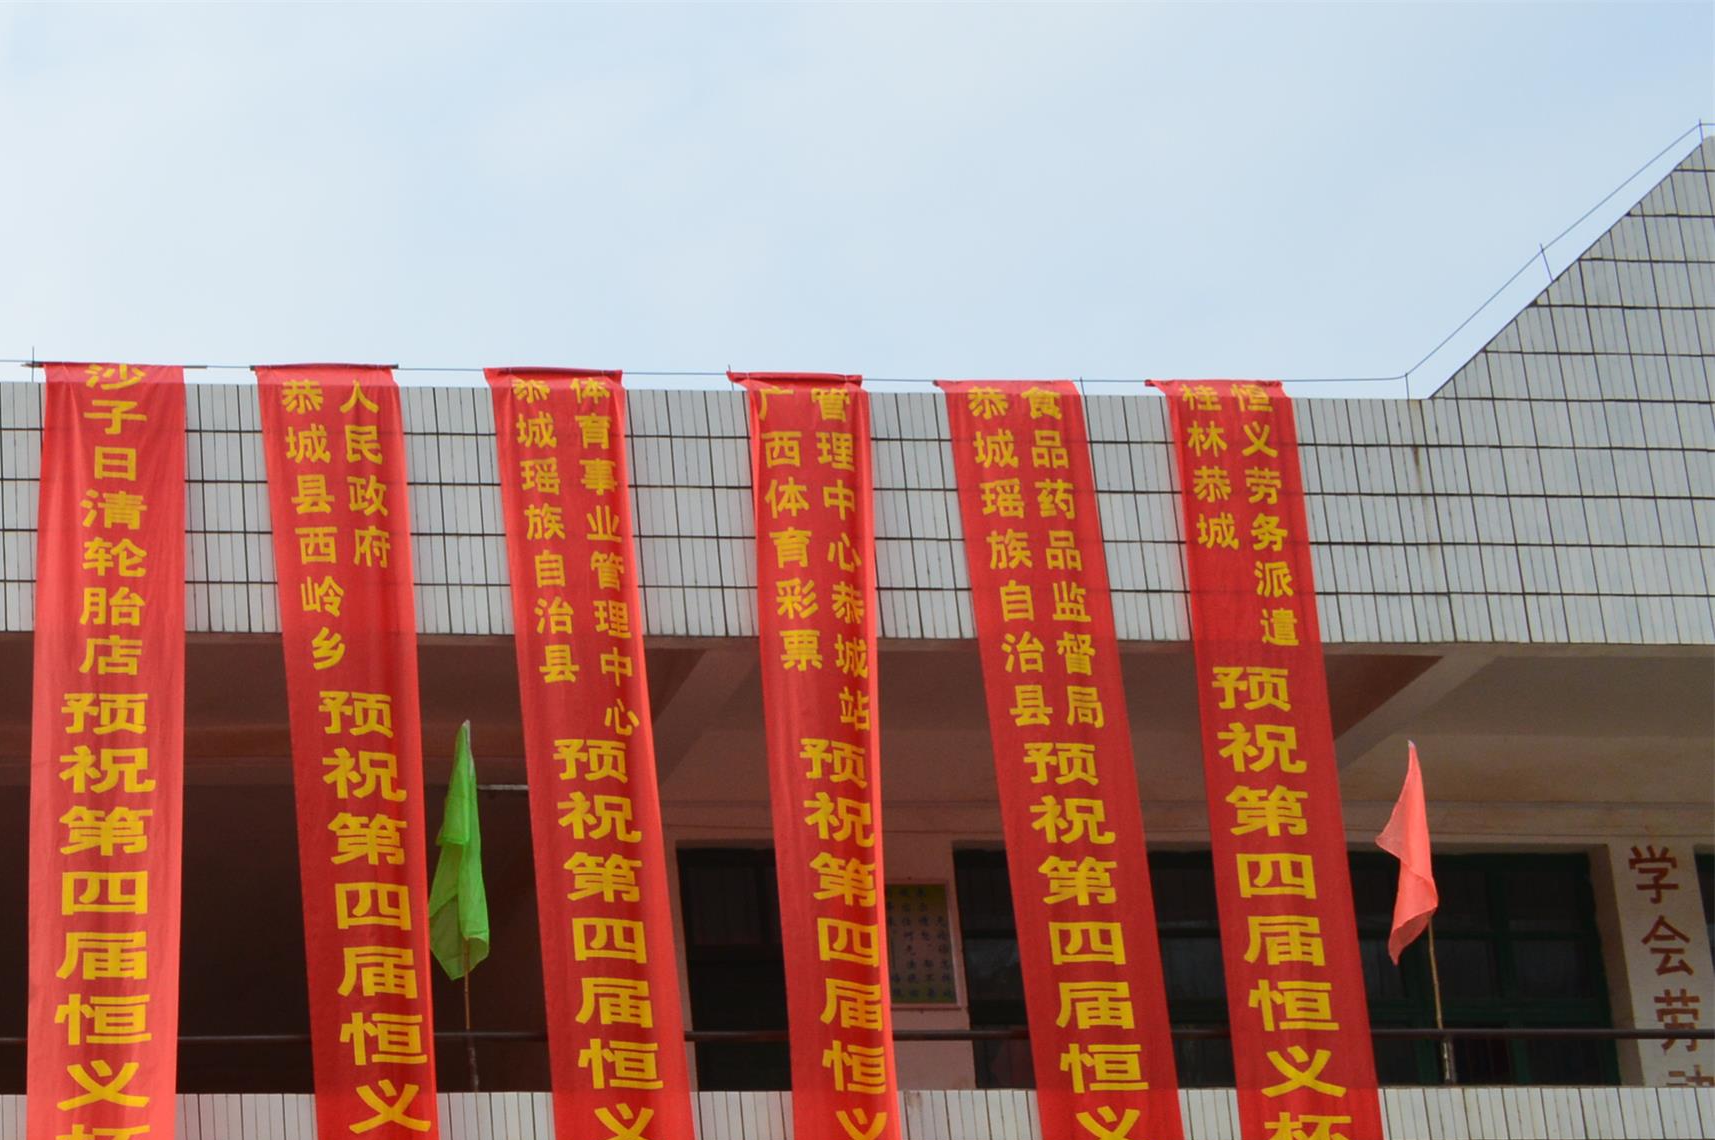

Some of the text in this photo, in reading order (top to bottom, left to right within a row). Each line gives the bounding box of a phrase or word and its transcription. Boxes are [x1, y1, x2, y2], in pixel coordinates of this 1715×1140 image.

[282, 380, 345, 670] 恭城县西岭乡
[340, 381, 390, 567] 人民政府
[514, 379, 579, 683] 恭城瑶族自治县
[570, 379, 639, 735] 体育事业管理中心
[759, 386, 822, 671] 广西体育彩票
[811, 388, 870, 730] 管理中心恭城站
[968, 387, 1053, 726] 恭城瑶族自治县
[1022, 387, 1104, 728] 食品药品监督局
[1182, 385, 1240, 549] 桂林恭城
[1231, 384, 1299, 646] 恒义劳务派遣
